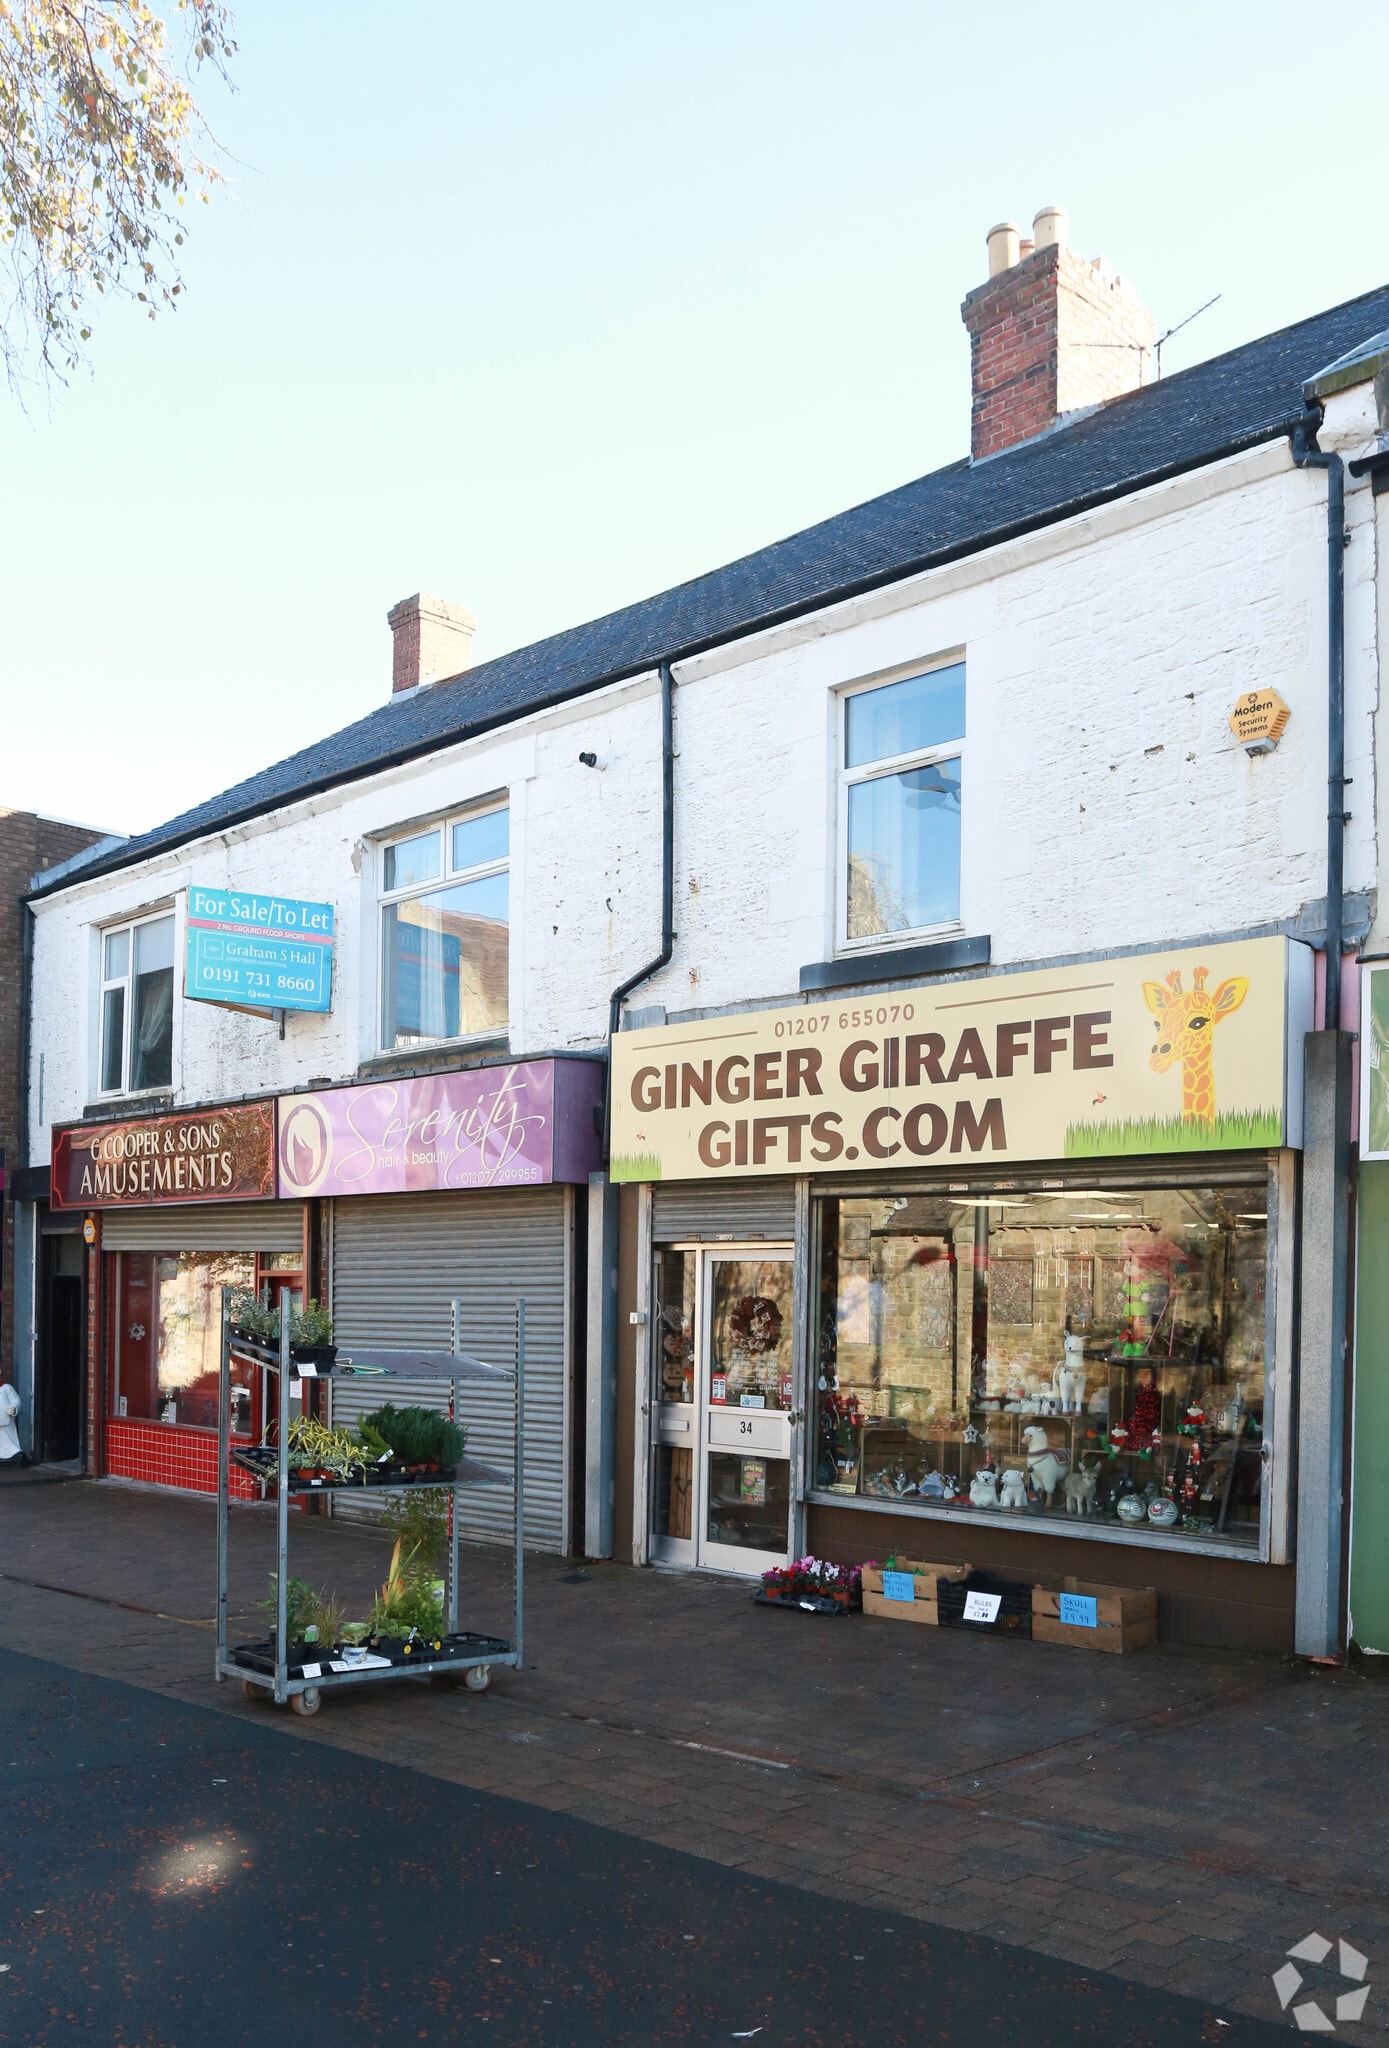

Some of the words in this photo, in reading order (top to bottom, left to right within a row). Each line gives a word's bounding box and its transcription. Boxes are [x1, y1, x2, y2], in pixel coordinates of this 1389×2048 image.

[1234, 701, 1273, 717] Modern
[1238, 715, 1268, 728] Security
[1239, 724, 1268, 737] Systems
[194, 893, 226, 916] For
[230, 899, 296, 926] Sale/To
[301, 907, 329, 929] Let
[234, 925, 262, 935] GROUND
[262, 928, 283, 937] FLOOR
[284, 931, 306, 940] SHOPS
[226, 942, 277, 960] Graham
[280, 949, 287, 961] S
[290, 951, 316, 965] Hall
[203, 966, 239, 983] 0191
[246, 971, 270, 987] 731
[277, 975, 315, 992] 8660
[774, 1015, 831, 1038] 01207
[838, 1003, 915, 1030] 655070
[630, 1047, 824, 1113] GINGER
[839, 1010, 1114, 1093] GIRAFFE
[163, 1129, 176, 1153] &
[178, 1123, 221, 1152] SONS
[334, 1064, 546, 1189] Serenity
[697, 1097, 1008, 1169] GIFTS.COM
[377, 1151, 402, 1169] hair
[402, 1153, 410, 1165] &
[411, 1149, 451, 1167] beauty
[80, 1151, 233, 1196] AMUSEMENTS
[498, 1167, 538, 1182] 299955
[739, 1421, 753, 1435] 34
[1063, 1596, 1090, 1609] SKULL
